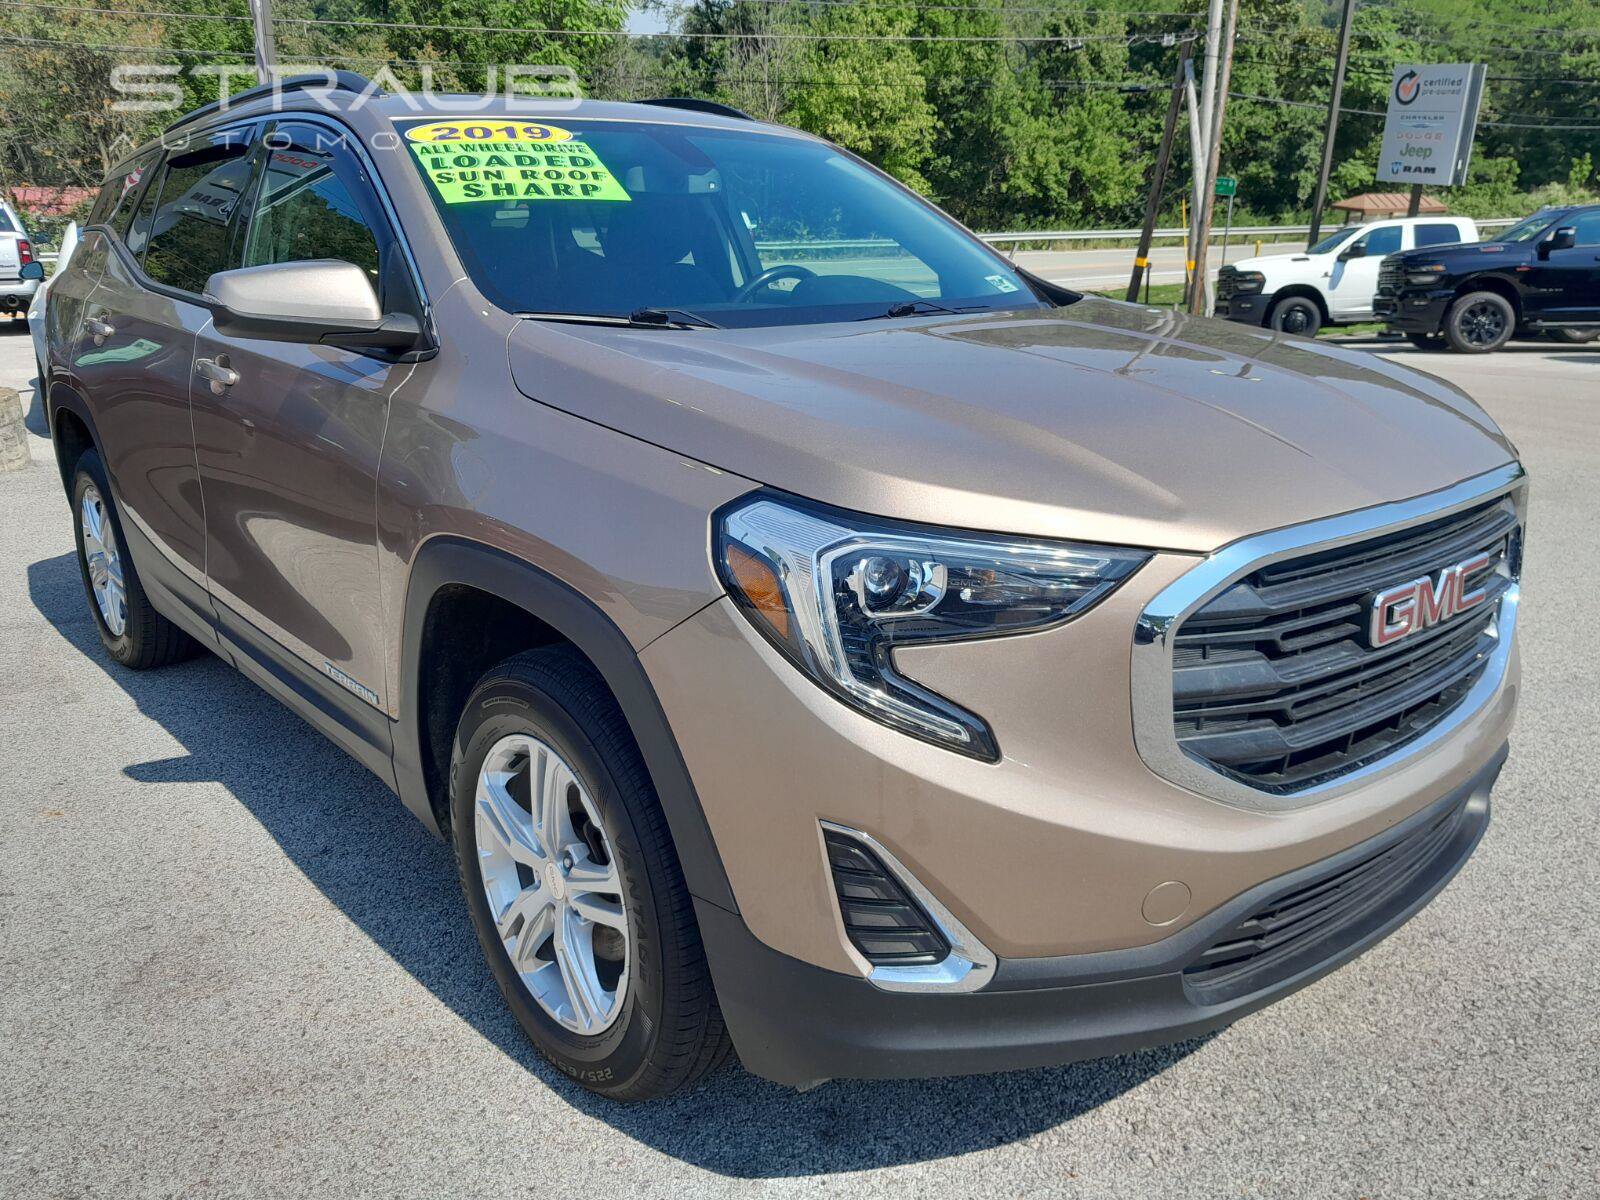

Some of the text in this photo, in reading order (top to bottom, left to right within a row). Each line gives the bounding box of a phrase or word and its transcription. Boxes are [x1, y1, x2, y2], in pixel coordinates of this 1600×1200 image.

[1423, 77, 1463, 87] certified
[431, 125, 552, 141] 2019
[419, 143, 590, 155] ALL WHEEL DRIVE
[1400, 143, 1433, 160] Jeep
[430, 154, 595, 170] LOADED
[1403, 165, 1437, 174] RAM
[436, 169, 608, 184] SUN ROOF
[463, 183, 602, 198] SHARP
[1370, 552, 1489, 648] GMC
